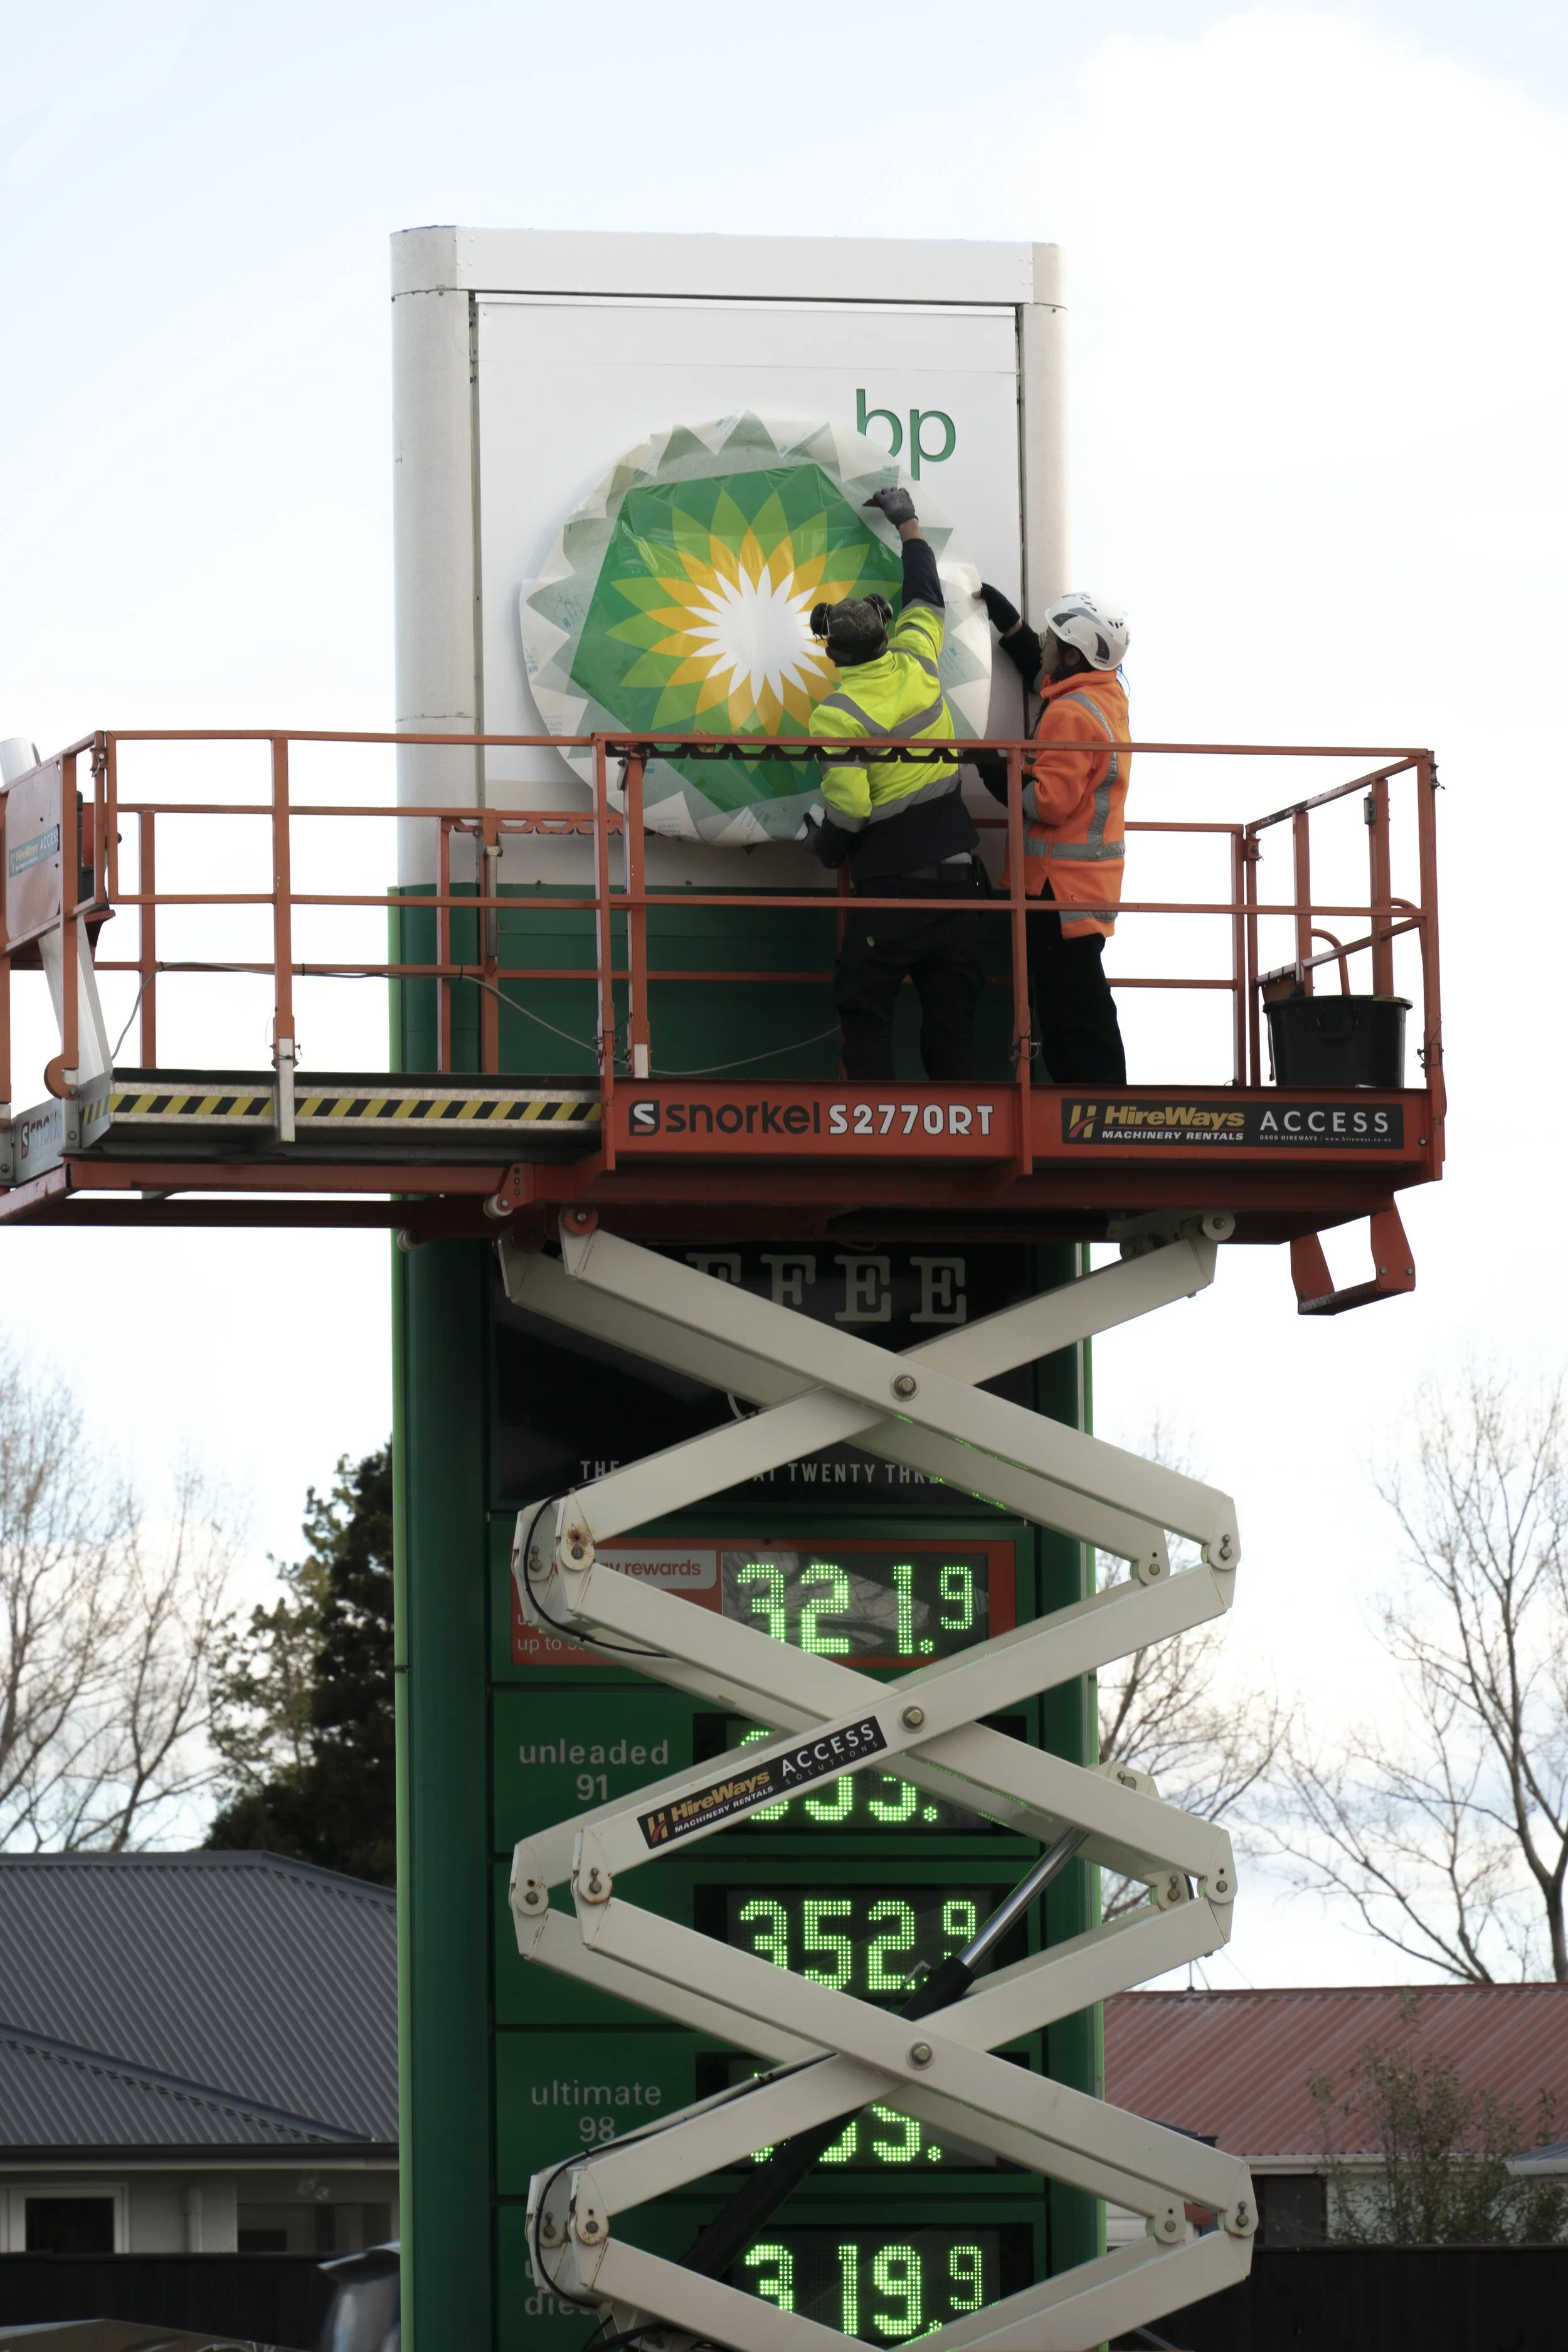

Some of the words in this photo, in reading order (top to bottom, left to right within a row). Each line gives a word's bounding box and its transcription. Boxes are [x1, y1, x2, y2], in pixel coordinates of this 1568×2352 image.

[856, 388, 956, 481] bp
[665, 1101, 820, 1135] snorkel
[829, 1103, 994, 1136] S2770RT
[1104, 1105, 1245, 1131] HireWays
[1259, 1111, 1389, 1133] ACCESS
[1102, 1131, 1182, 1140] MACHINERY
[1186, 1132, 1244, 1141] RENTALS
[788, 1463, 876, 1483] TWENTY
[624, 1559, 702, 1576] rewards
[517, 1638, 539, 1655] up
[544, 1636, 562, 1651] to
[519, 1739, 669, 1765] unleaded
[781, 1724, 874, 1777] ACCESS
[785, 1740, 878, 1786] SOLUTIONS
[576, 1774, 608, 1801] 91
[671, 1771, 771, 1822] HireWays
[674, 1805, 731, 1833] MACHINERY
[733, 1786, 774, 1808] RENTALS
[531, 2080, 662, 2106] ultimate
[579, 2116, 615, 2143] 98
